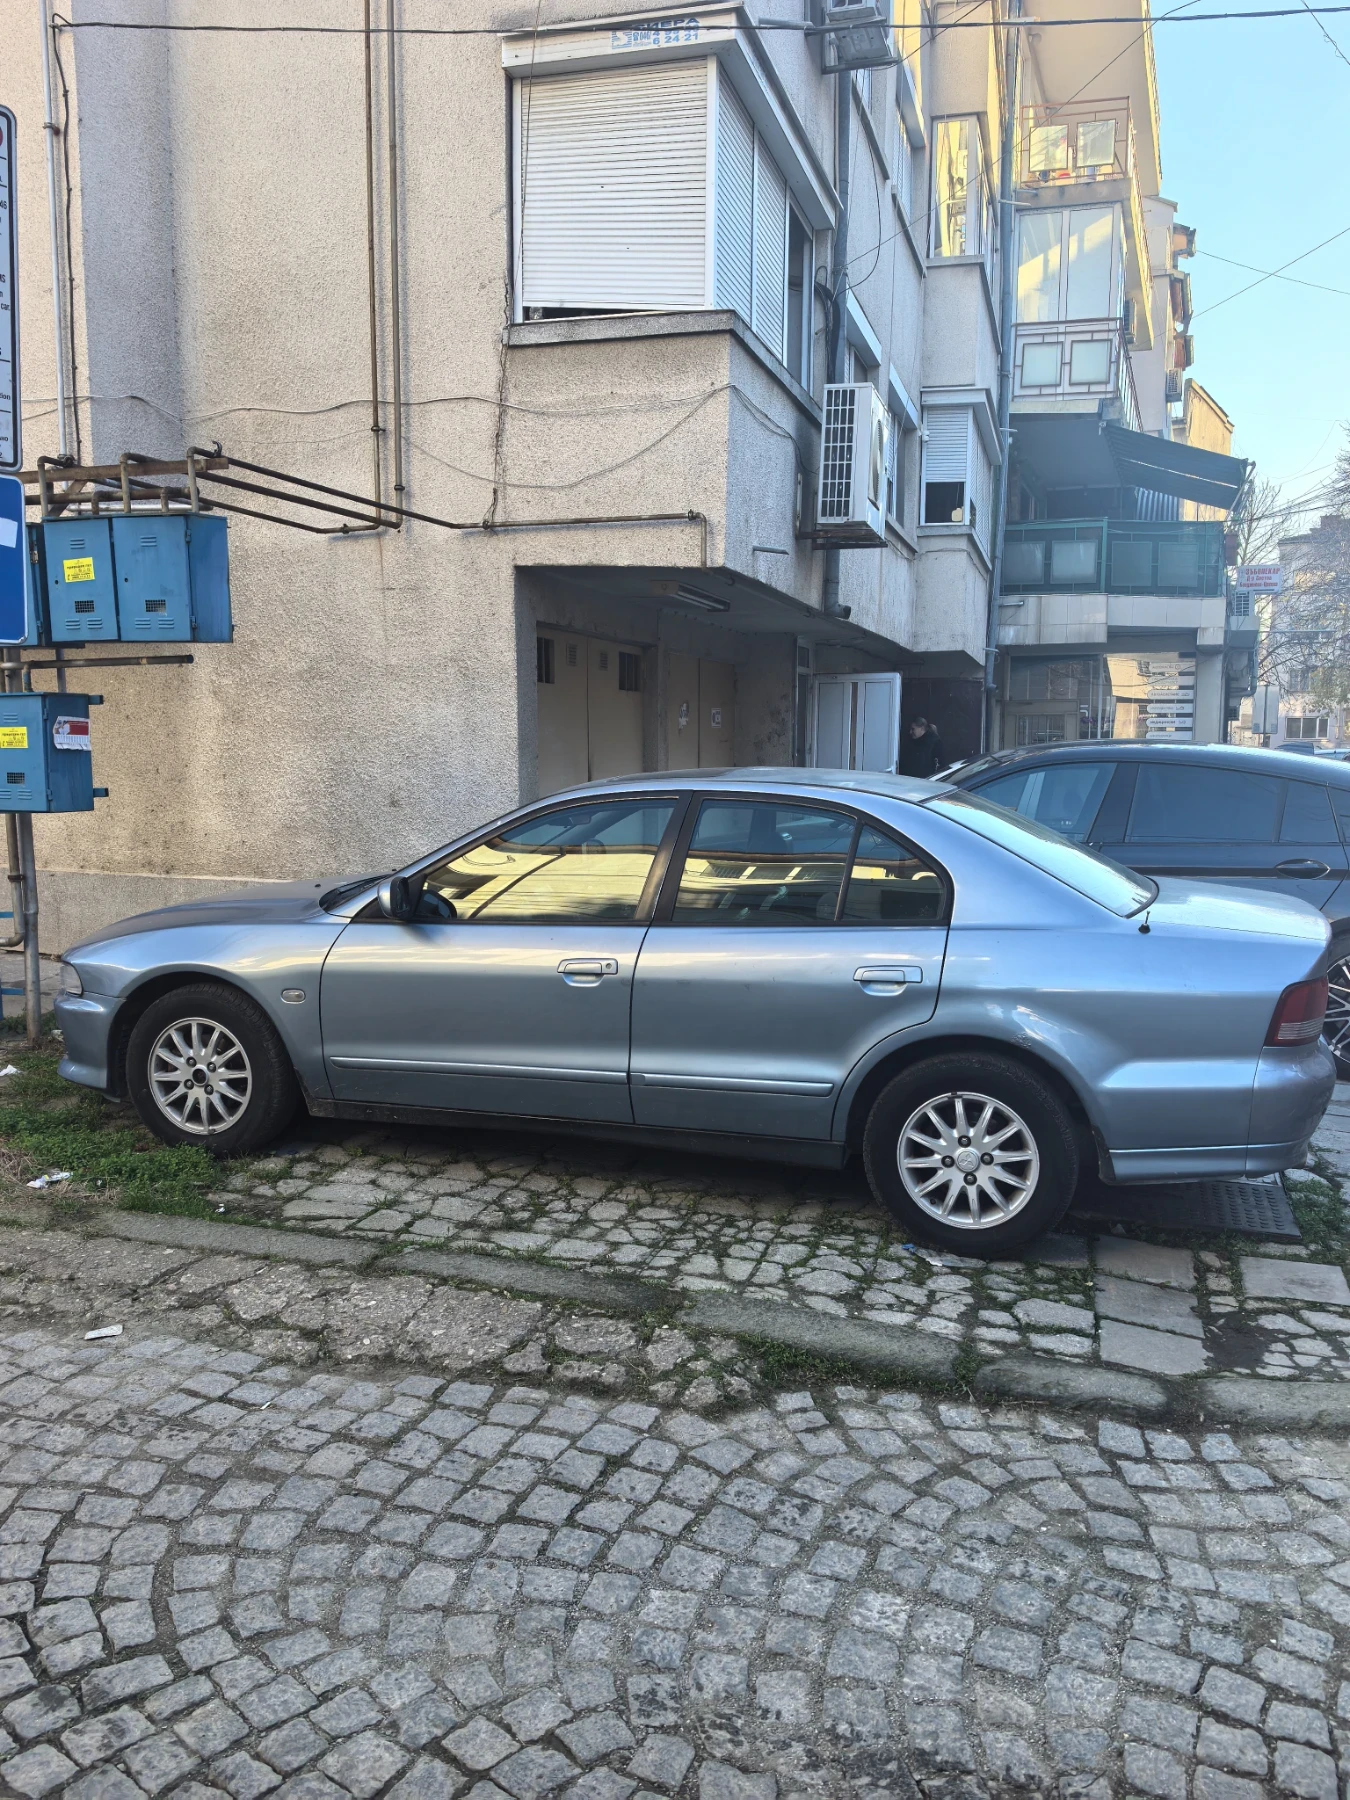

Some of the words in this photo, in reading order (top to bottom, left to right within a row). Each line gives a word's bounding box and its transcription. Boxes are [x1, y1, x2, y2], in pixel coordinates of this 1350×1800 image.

[653, 37, 660, 45] 6
[664, 34, 680, 43] 24
[684, 32, 698, 41] 21
